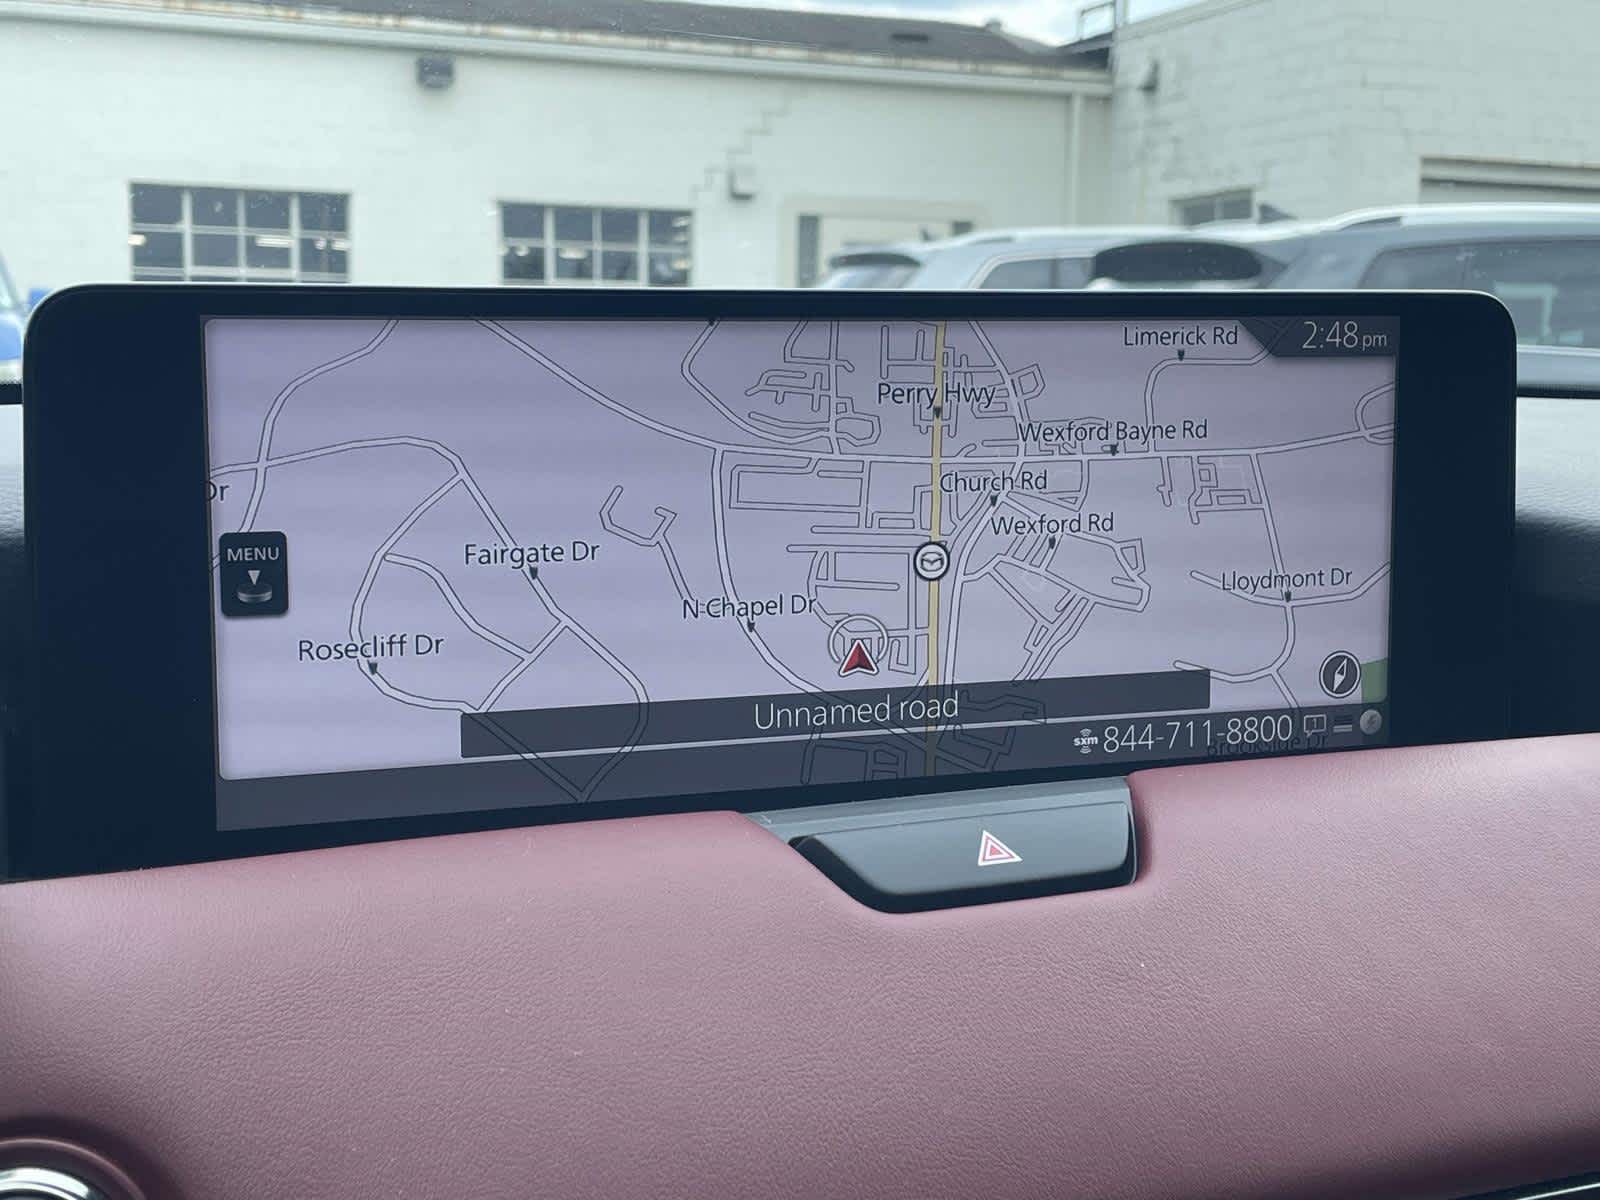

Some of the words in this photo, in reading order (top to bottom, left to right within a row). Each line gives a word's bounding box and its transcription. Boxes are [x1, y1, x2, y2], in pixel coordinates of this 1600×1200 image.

[1124, 325, 1207, 346] Limerick
[1213, 325, 1238, 345] Rd
[878, 382, 938, 410] Perry
[945, 382, 996, 409] Hwy
[1018, 420, 1109, 442] Wexford
[1116, 421, 1176, 445] Bayne
[1182, 419, 1207, 438] Rd
[940, 471, 1014, 492] Church
[1021, 470, 1047, 489] Rd
[991, 513, 1081, 535] Wexford
[1088, 512, 1114, 532] Rd
[227, 547, 279, 561] MENU
[465, 542, 564, 569] Fairgate
[572, 540, 600, 561] Dr
[1222, 568, 1325, 595] Lloydmont
[1331, 567, 1353, 586] Dr
[706, 593, 783, 620] Chapel
[791, 595, 816, 614] Dr
[299, 634, 407, 661] Rosecliff
[415, 634, 444, 655] Dr
[755, 694, 890, 730] Unnamed
[899, 690, 959, 720] road
[1073, 735, 1098, 747] sxm
[1103, 715, 1293, 753] 844-711-8800
